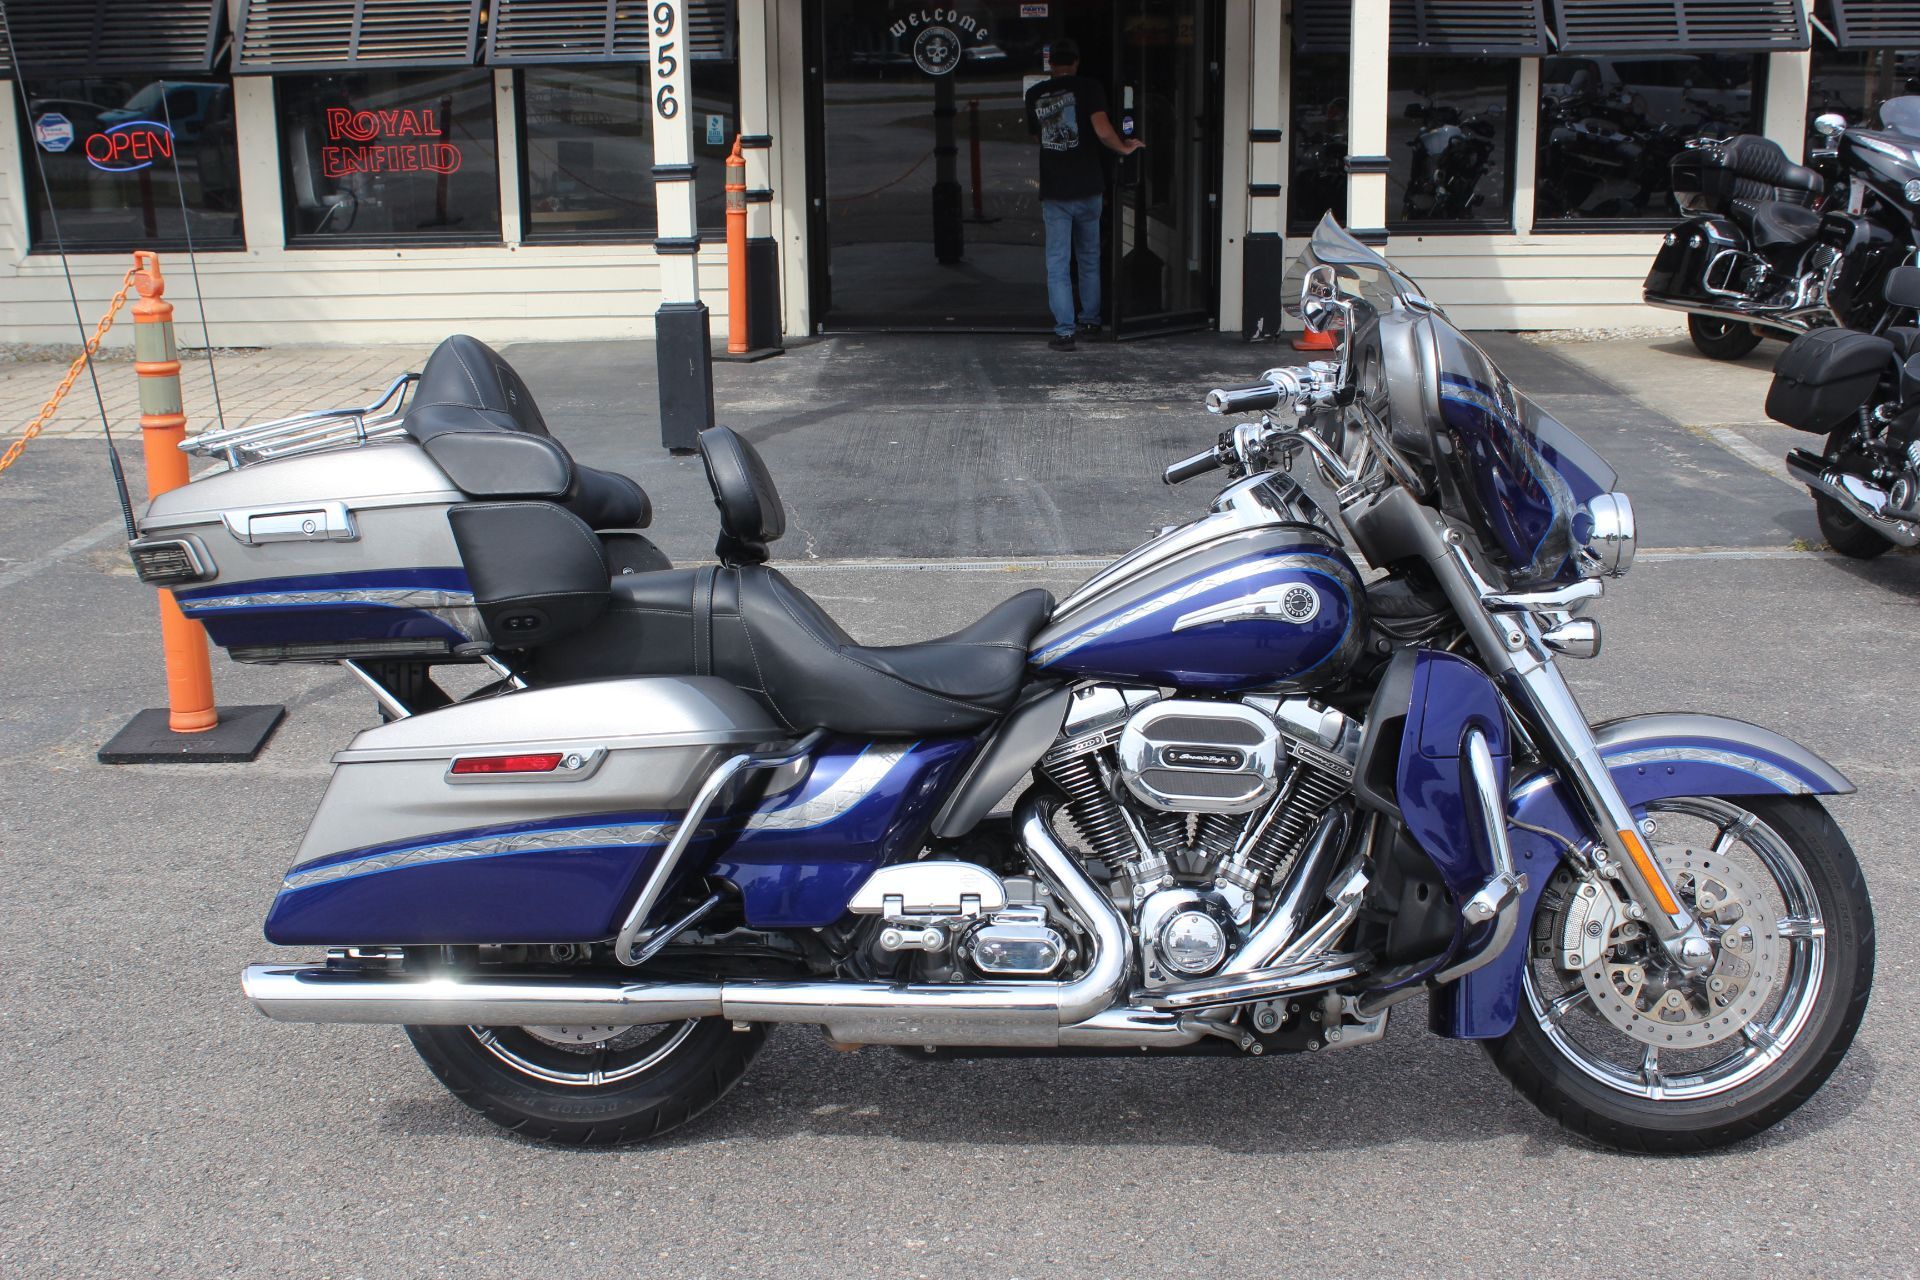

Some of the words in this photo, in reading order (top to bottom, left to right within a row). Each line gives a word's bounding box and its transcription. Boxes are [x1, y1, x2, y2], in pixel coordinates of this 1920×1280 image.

[653, 2, 679, 119] 956
[326, 107, 442, 141] ROYAL
[85, 130, 171, 162] OPEN
[322, 143, 462, 177] ENFIELD
